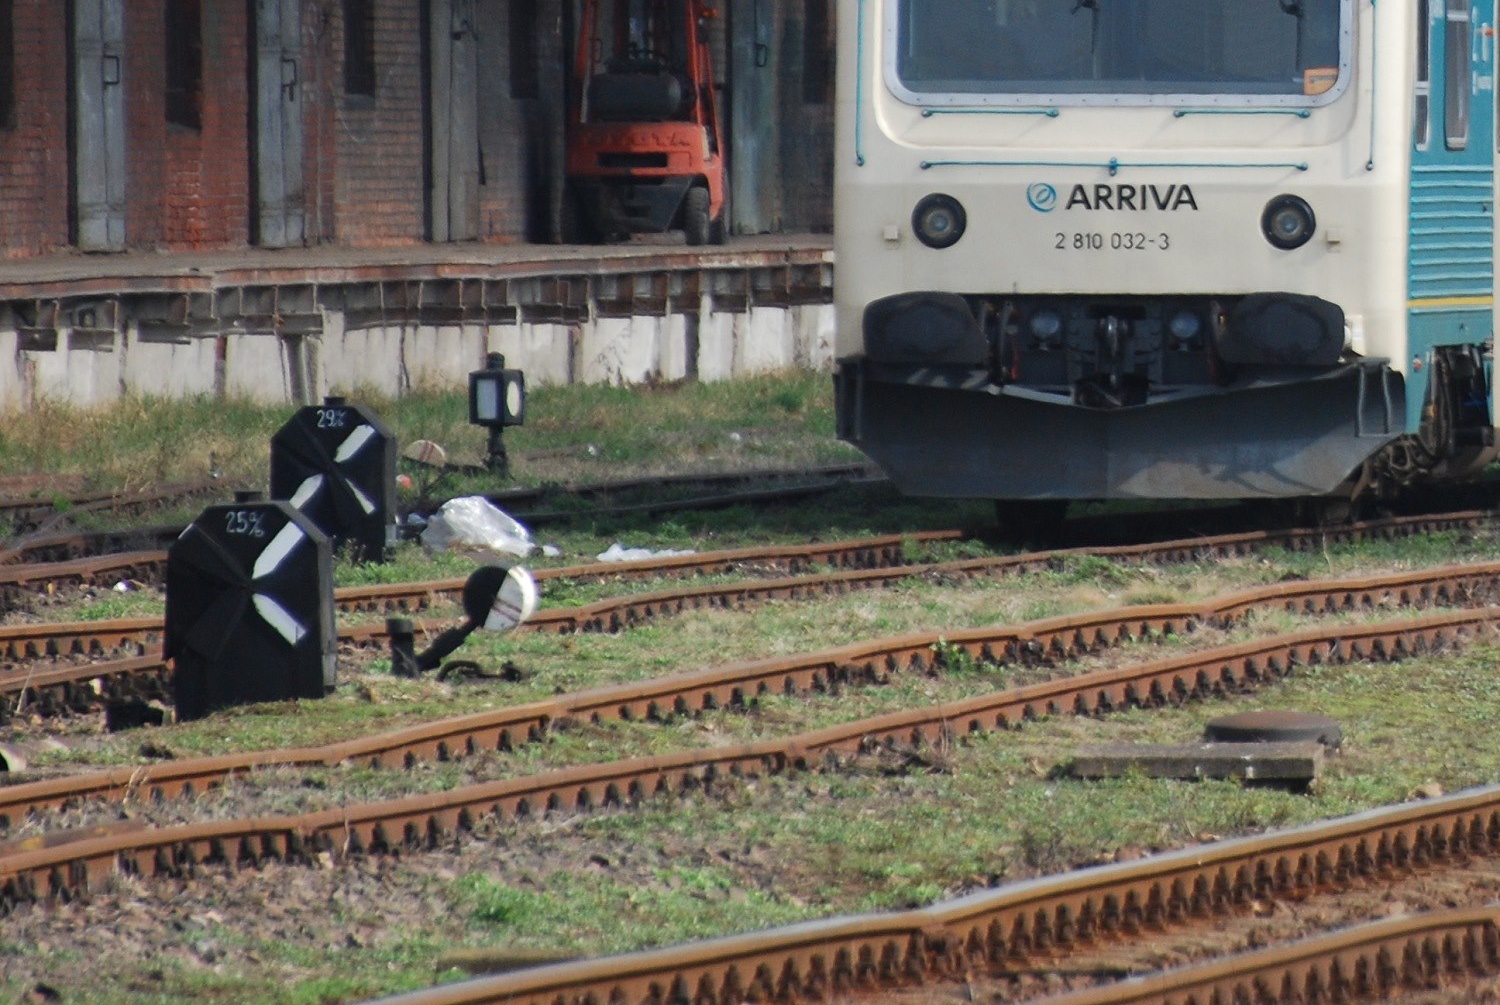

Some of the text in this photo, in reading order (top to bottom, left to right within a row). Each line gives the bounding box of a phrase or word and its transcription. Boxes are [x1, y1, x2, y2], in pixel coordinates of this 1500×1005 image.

[1065, 183, 1199, 211] ARRIVA
[1054, 232, 1170, 250] 2 810 032-3
